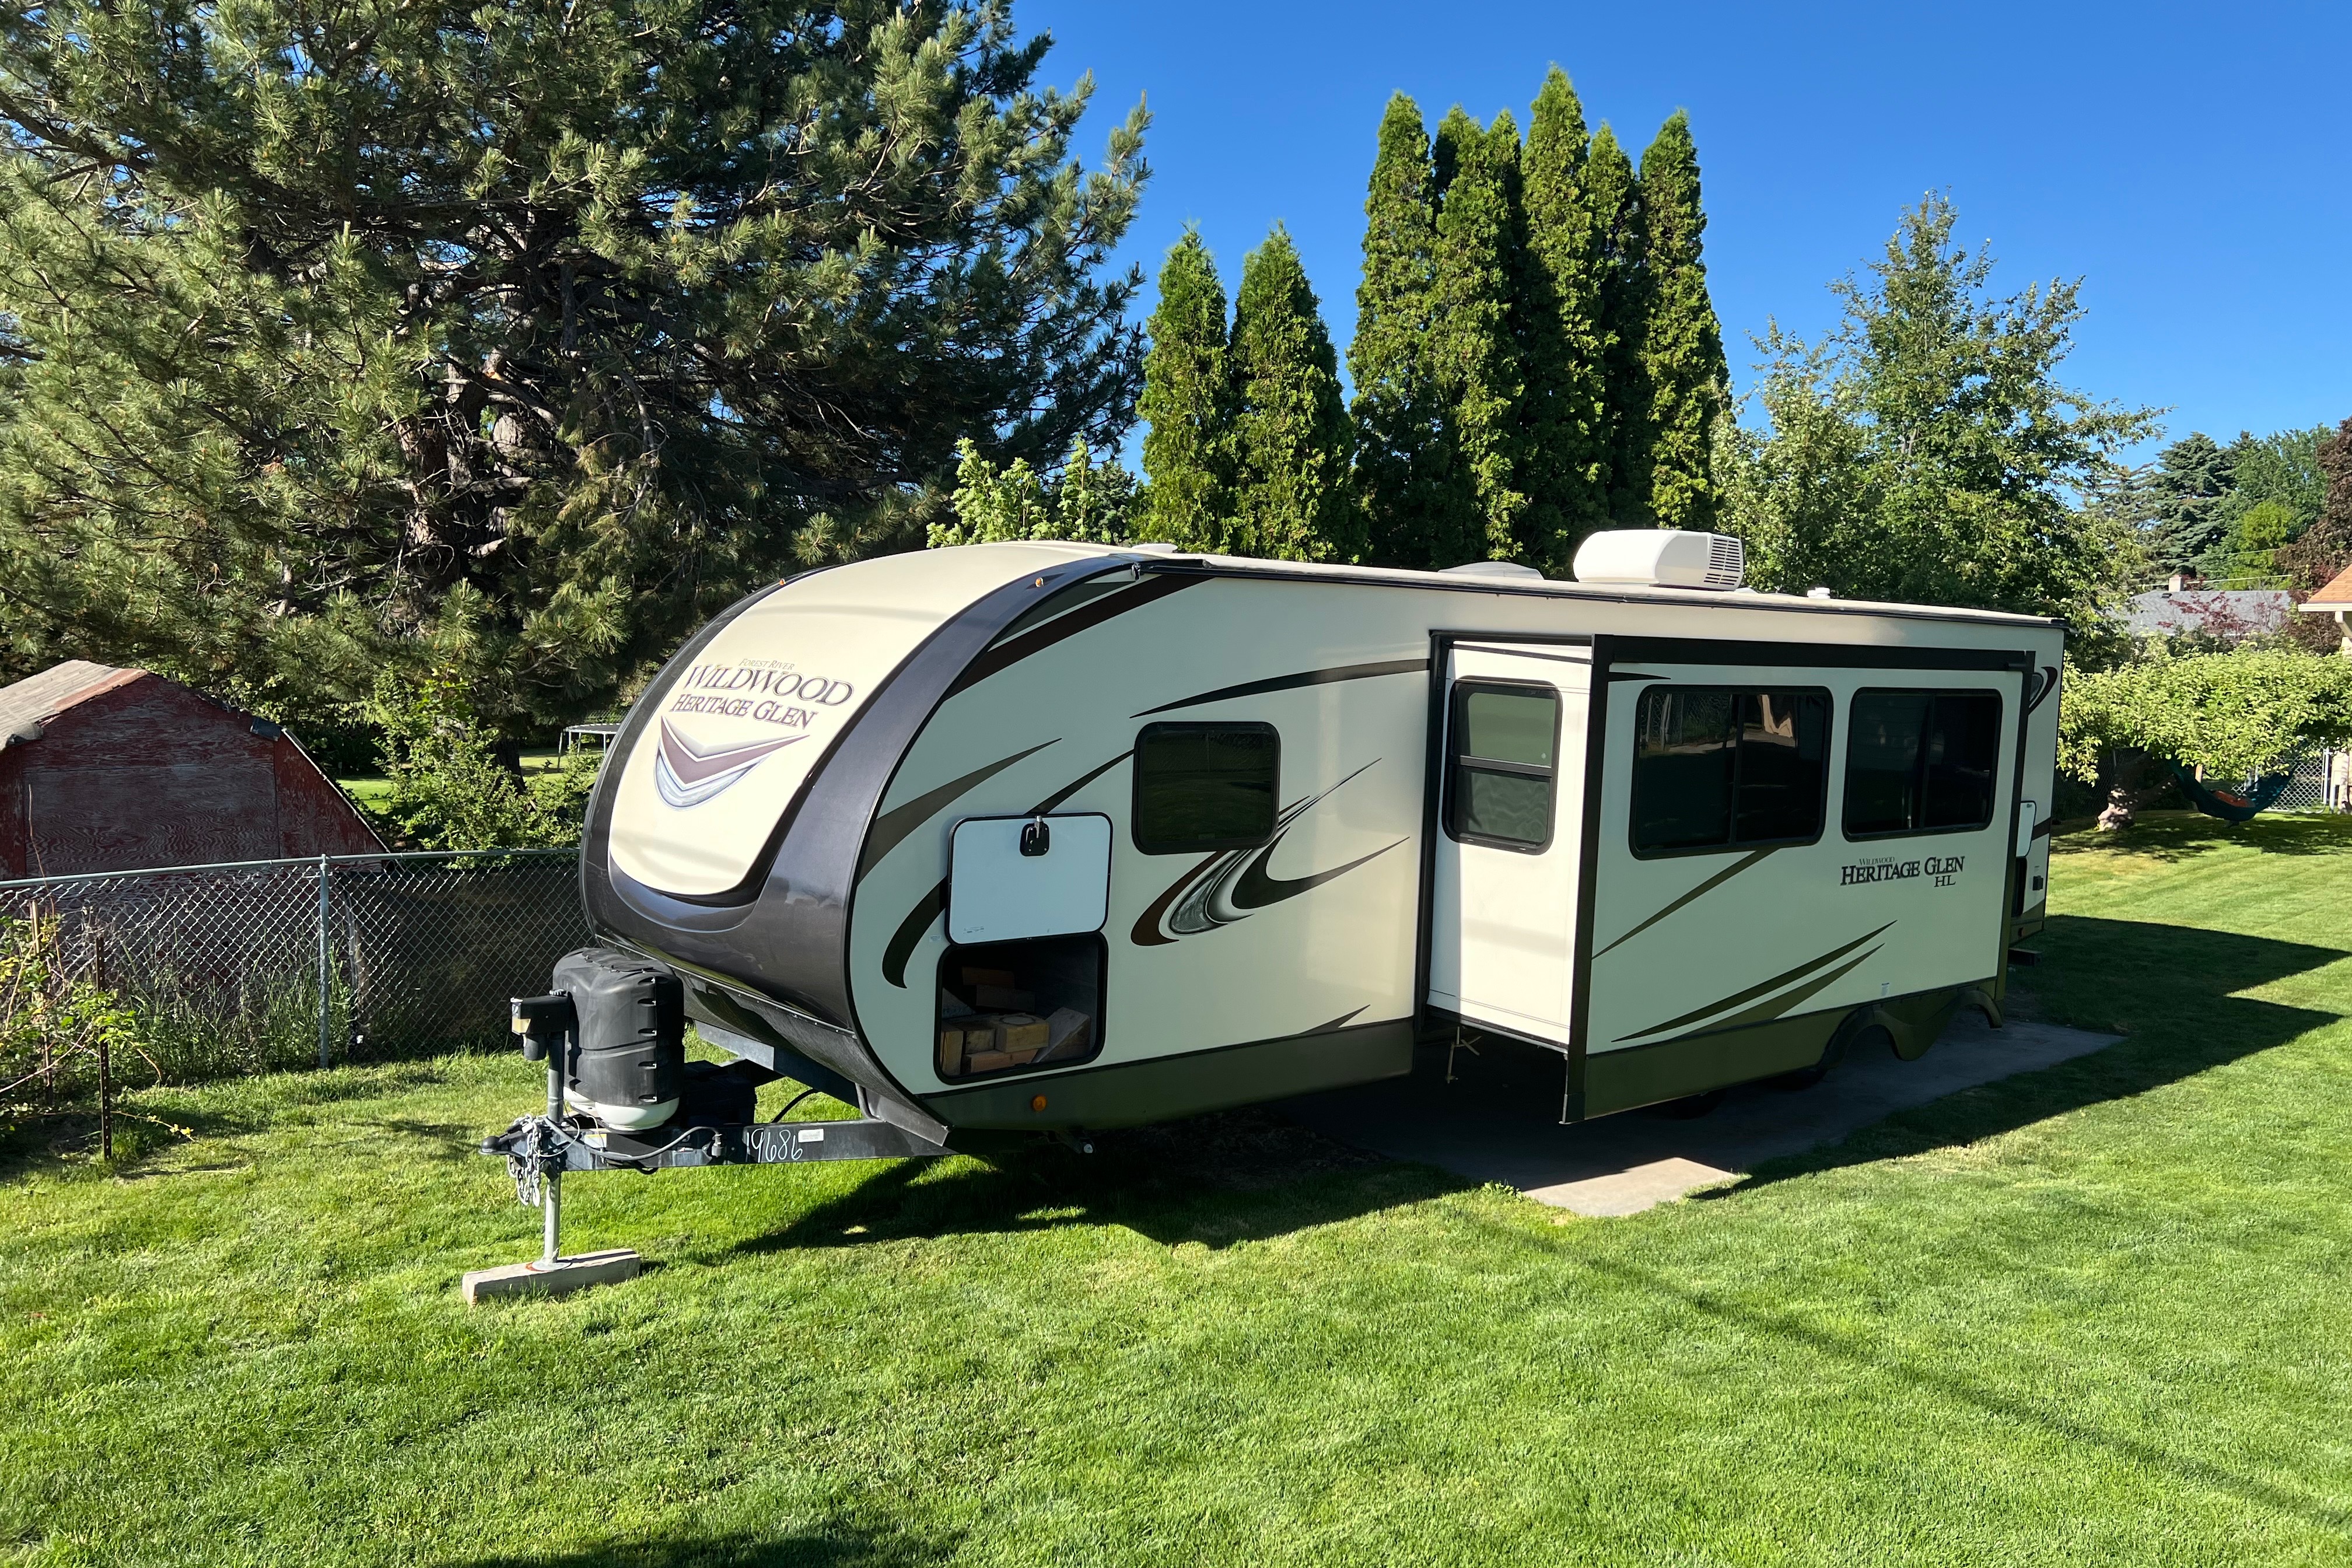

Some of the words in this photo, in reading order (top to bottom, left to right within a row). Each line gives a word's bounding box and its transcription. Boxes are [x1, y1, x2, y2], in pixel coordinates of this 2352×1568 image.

[738, 658, 770, 667] FOREST
[768, 660, 794, 670] RIVER
[682, 663, 855, 706] WILDWOOD
[669, 694, 754, 718] HERITAGE
[752, 700, 818, 730] GLEN
[1840, 860, 1920, 886] HERITAGE
[1924, 856, 1966, 876] GLEN
[1859, 856, 1895, 866] WILDWOOD
[1934, 874, 1957, 888] HL
[746, 1128, 803, 1163] 19686
